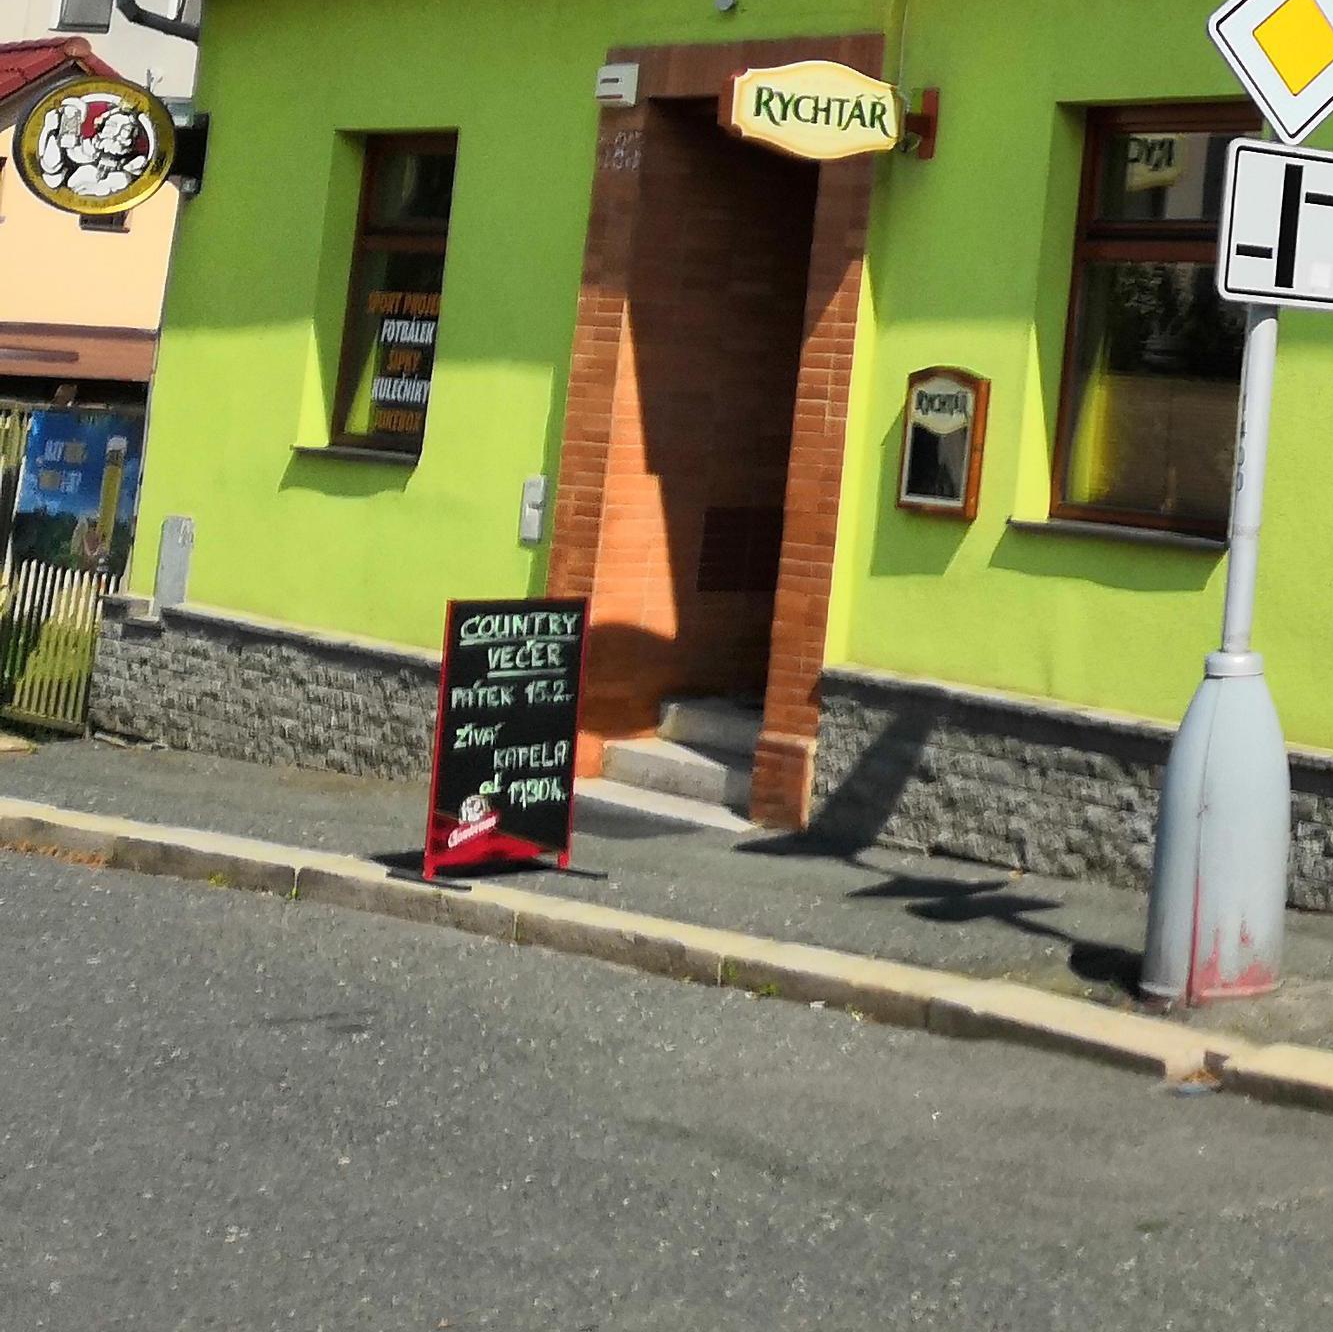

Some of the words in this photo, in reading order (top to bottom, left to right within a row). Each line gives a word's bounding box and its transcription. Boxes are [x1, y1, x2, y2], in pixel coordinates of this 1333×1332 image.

[753, 85, 898, 139] RYCHTÁŘ
[380, 317, 437, 344] FOTBÁLEK
[460, 612, 580, 639] COUNTRY
[488, 640, 563, 669] VEČER
[493, 740, 569, 770] KAPELA
